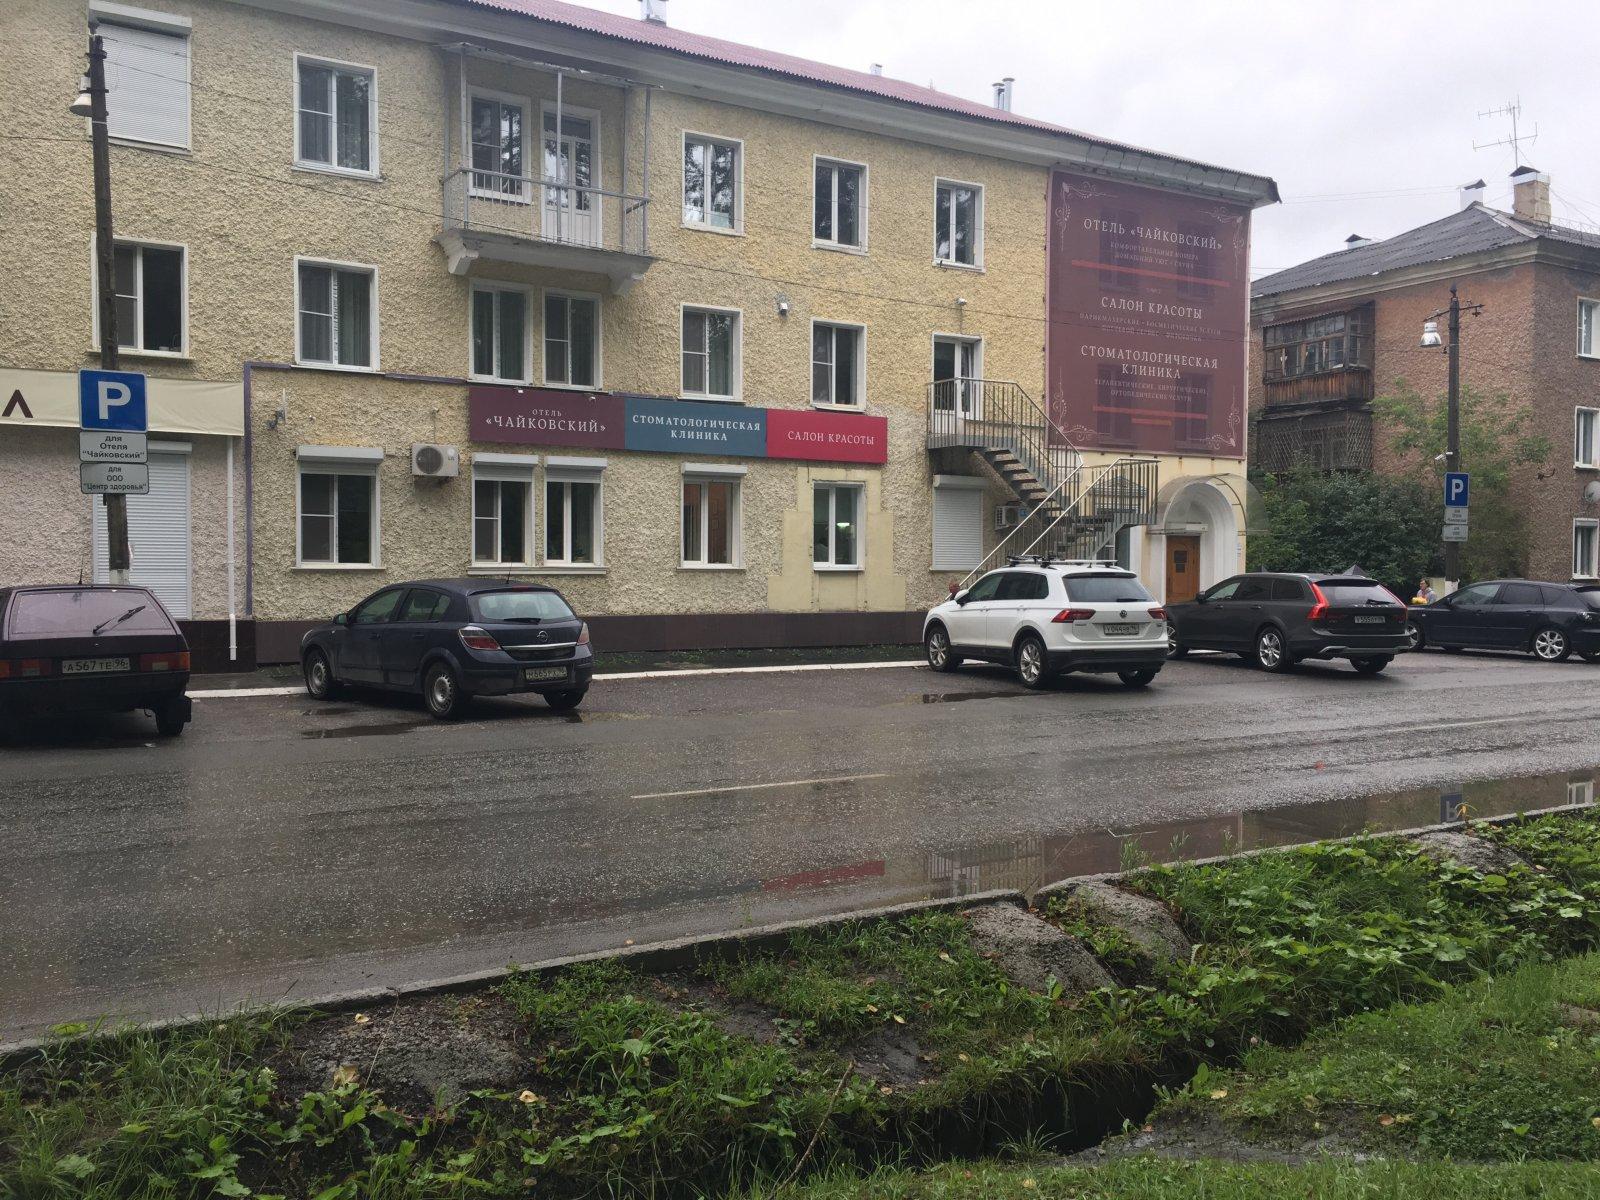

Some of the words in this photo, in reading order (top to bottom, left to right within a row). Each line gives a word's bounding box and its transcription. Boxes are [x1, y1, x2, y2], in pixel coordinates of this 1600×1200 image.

[1083, 218, 1126, 235] ОТЕЛЬ
[1130, 225, 1223, 250] «ЧАЙКОВСКИЙ»
[1101, 297, 1144, 313] САЛОН
[1148, 301, 1203, 320] КРАСОТЫ
[1081, 345, 1218, 370] СТОМАТОЛОГИЧЕСКАЯ
[1122, 364, 1182, 380] КЛИНИКА
[98, 381, 131, 419] P
[532, 408, 562, 418] ОТЕЛЬ
[632, 414, 761, 431] СТОМАТОЛОГИЧЕСКАЯ
[486, 415, 606, 434] «ЧАЙКОВСКИЙ»
[671, 430, 728, 442] КЛИНИКА
[787, 430, 825, 443] САЛОН
[828, 433, 875, 446] КРАСОТЫ
[1451, 479, 1464, 501] P
